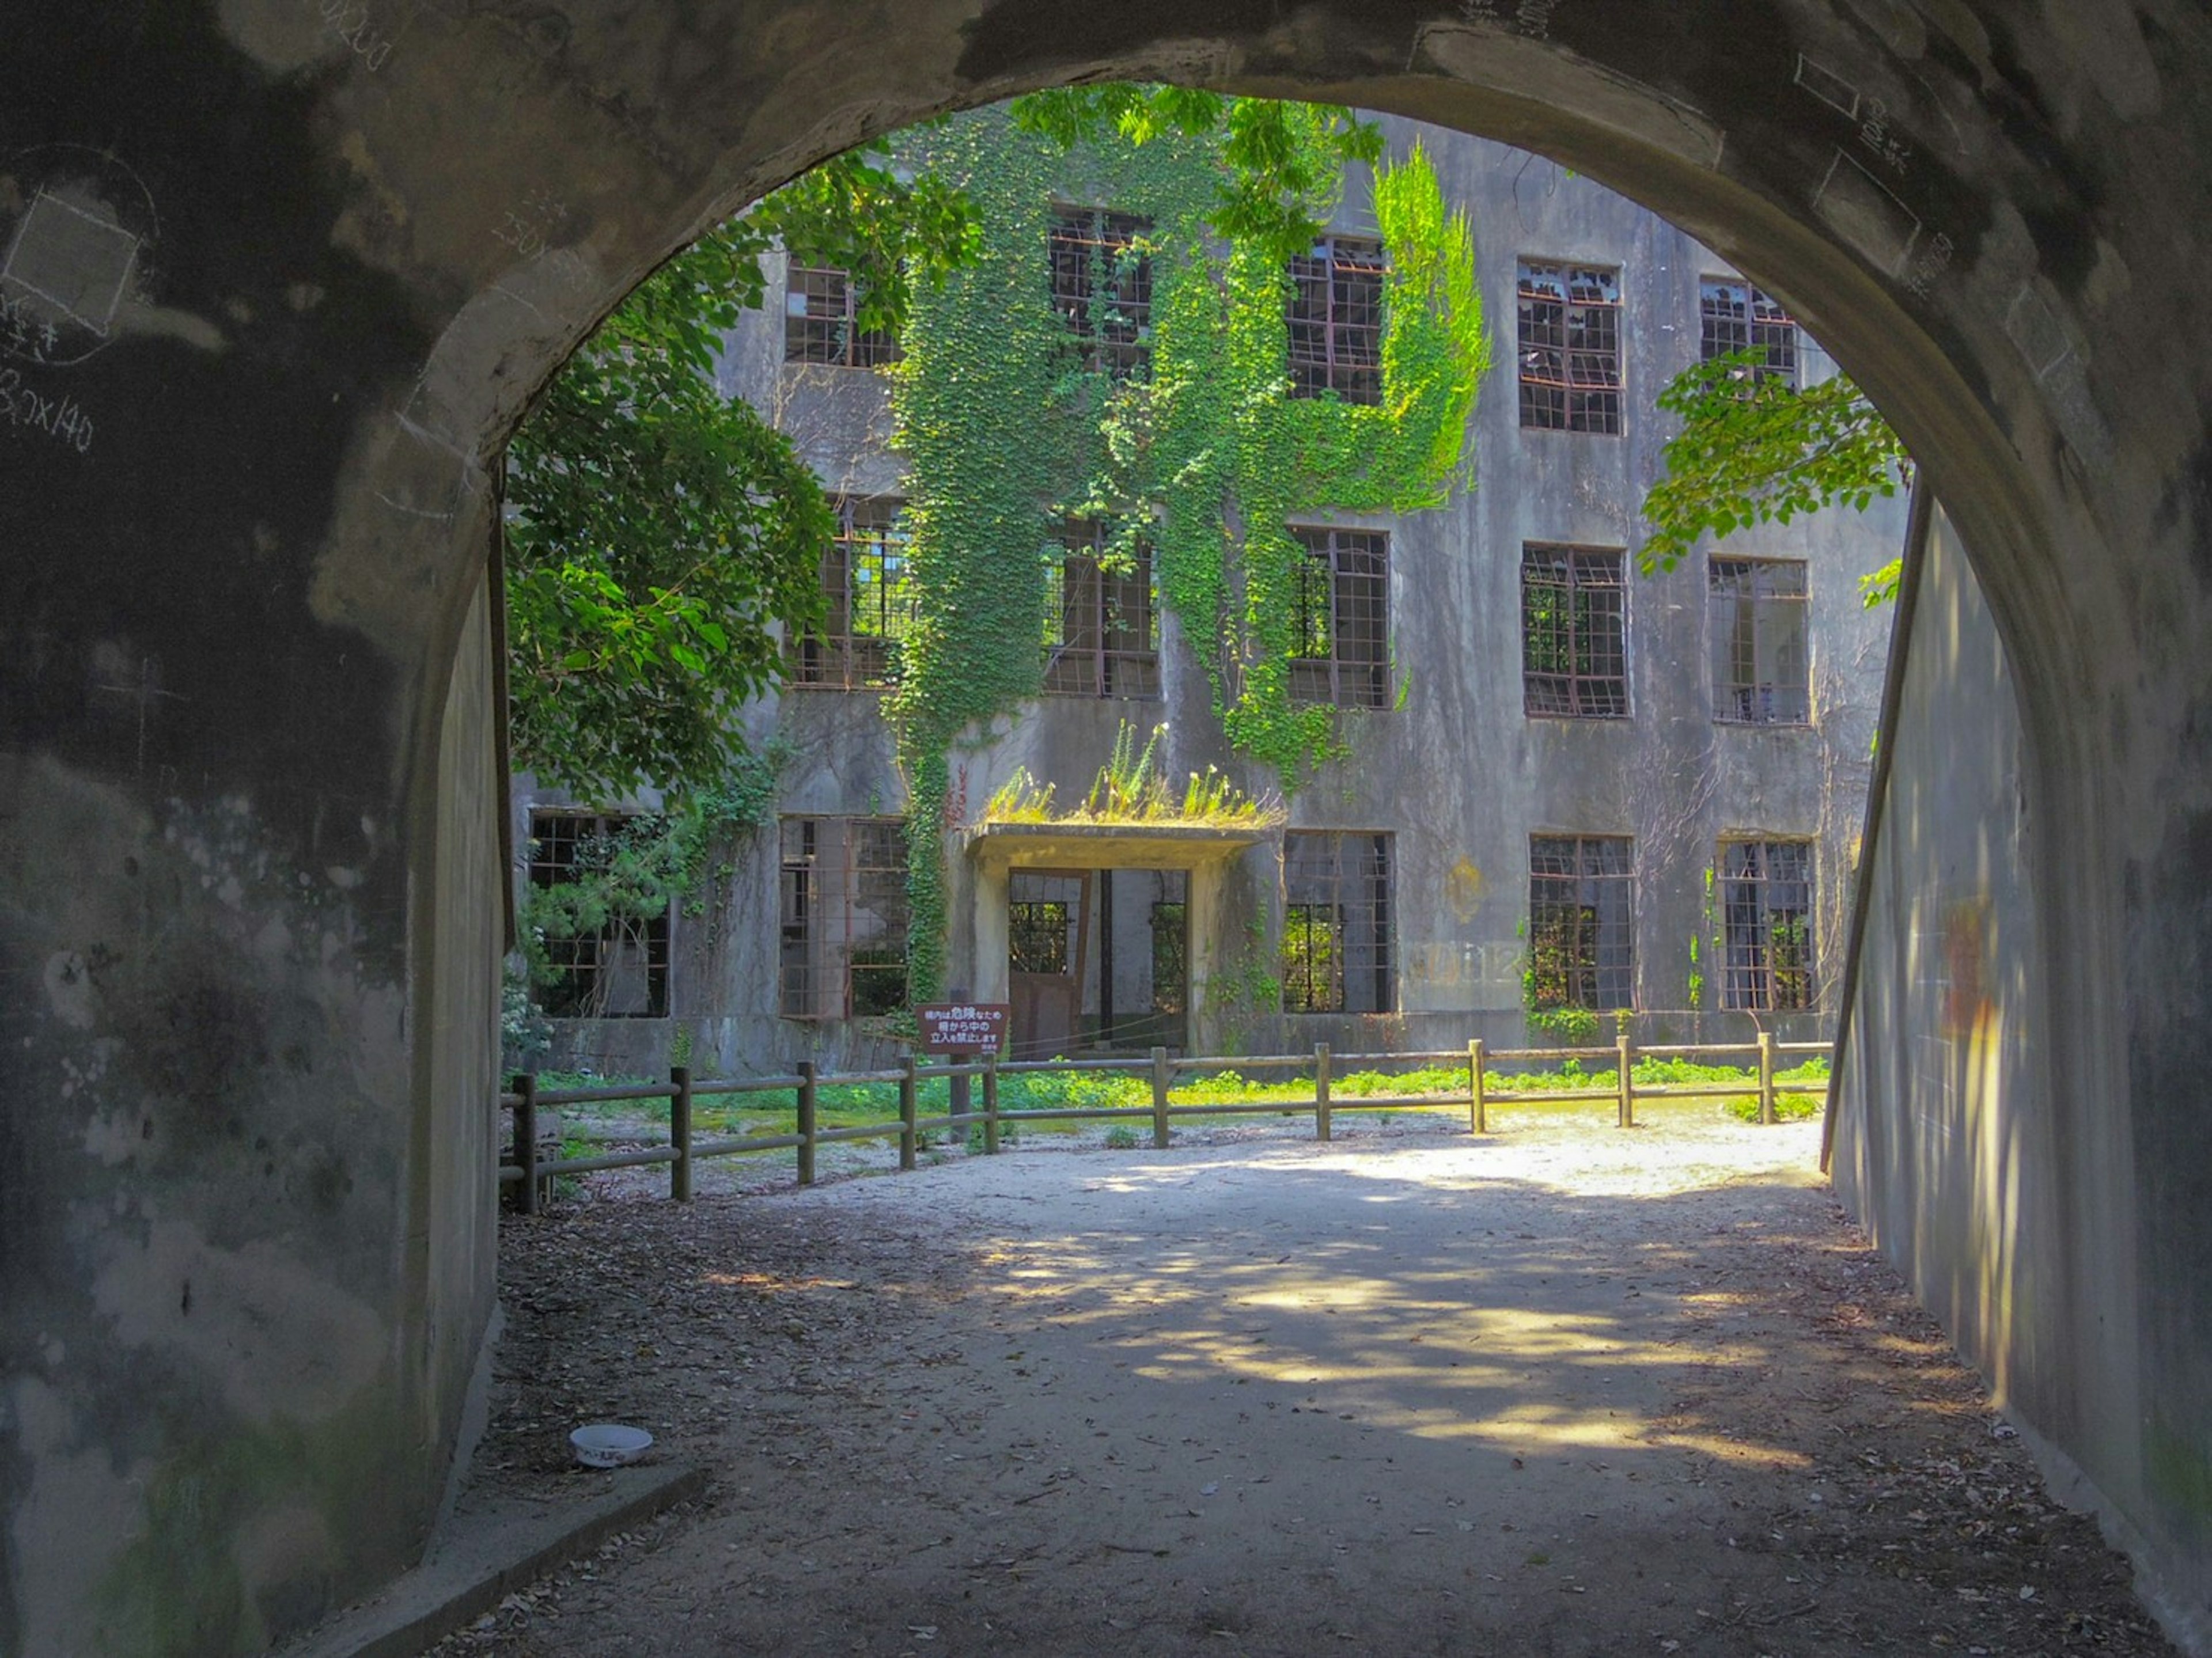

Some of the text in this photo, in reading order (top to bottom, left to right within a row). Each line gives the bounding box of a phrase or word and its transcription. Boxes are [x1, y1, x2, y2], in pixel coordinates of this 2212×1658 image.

[930, 1032, 997, 1044] 立入を禁止します
